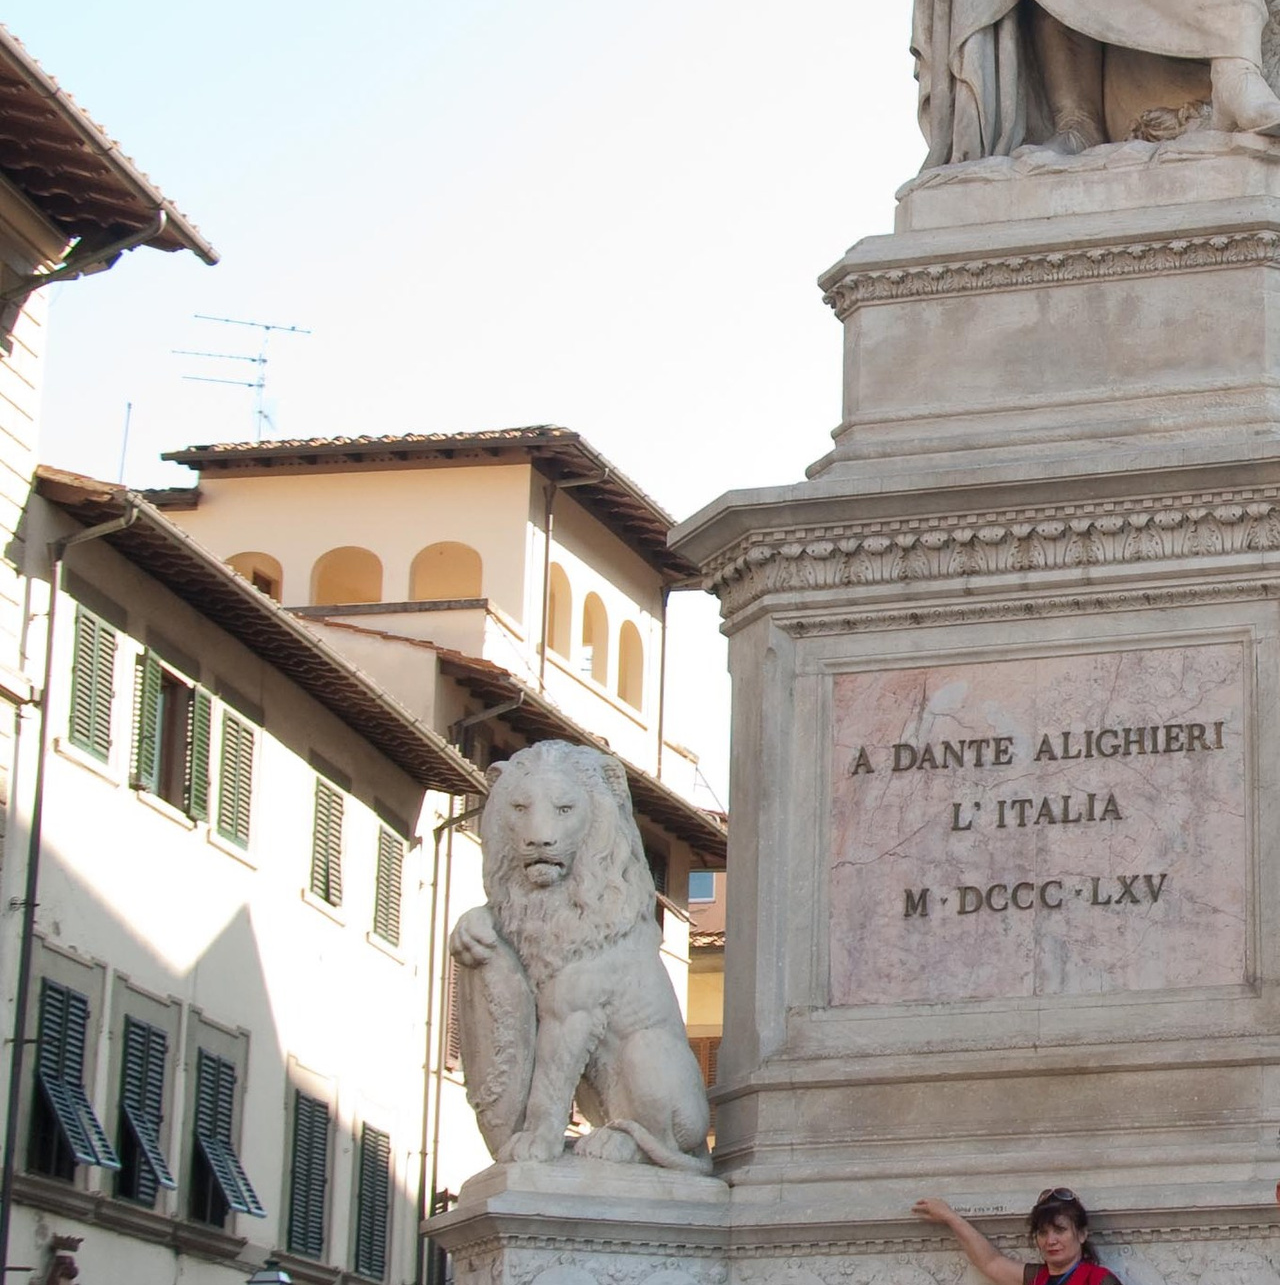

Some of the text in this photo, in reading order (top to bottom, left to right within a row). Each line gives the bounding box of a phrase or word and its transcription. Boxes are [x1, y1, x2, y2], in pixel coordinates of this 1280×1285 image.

[851, 720, 1225, 775] A DANTE ALIGHIERI
